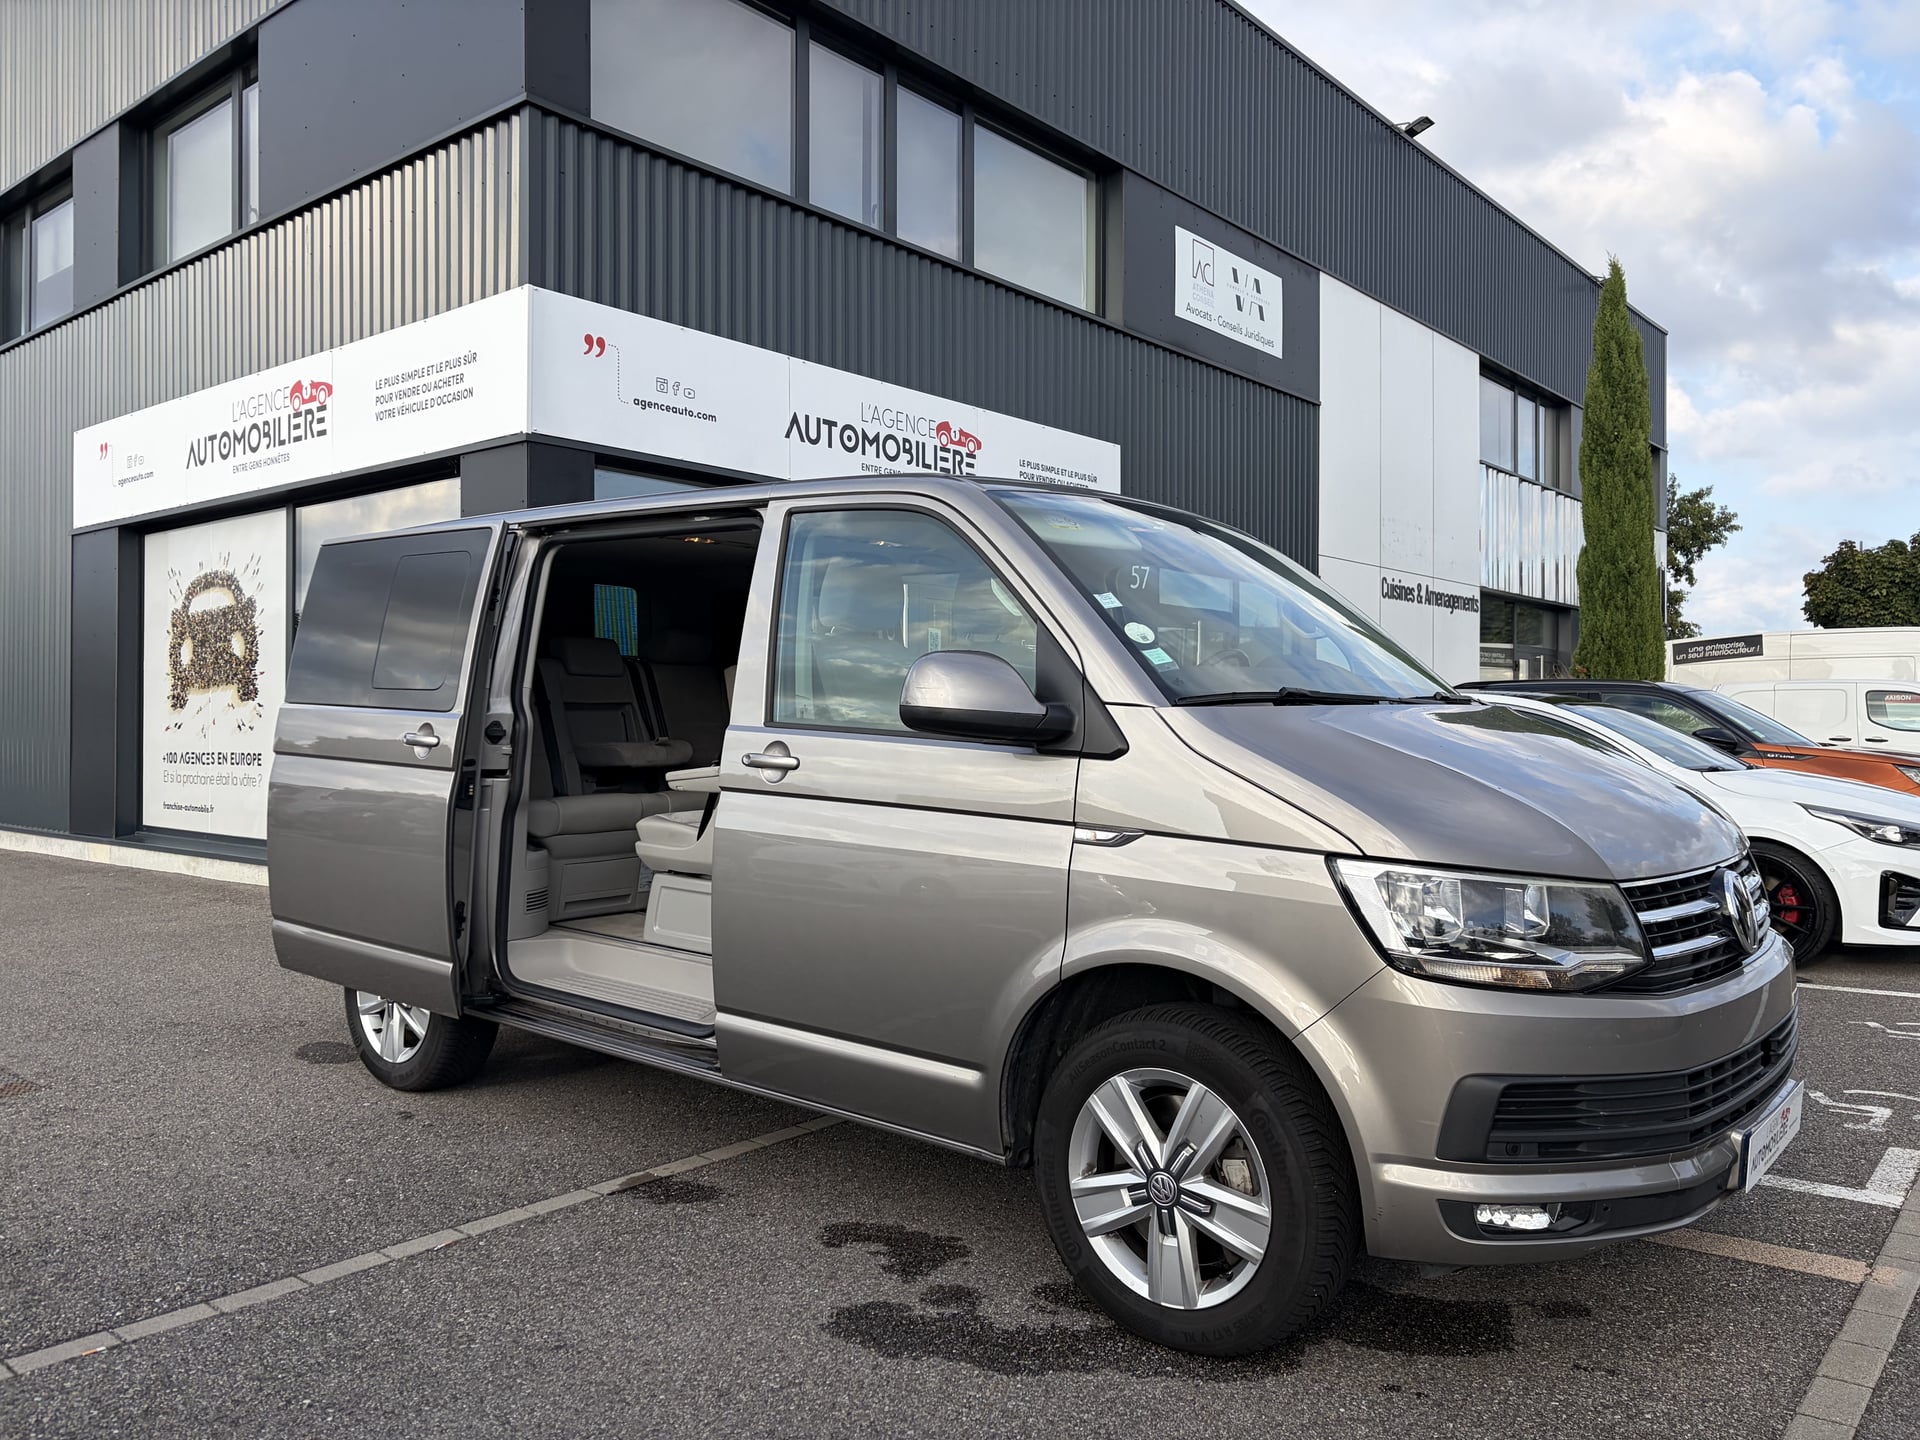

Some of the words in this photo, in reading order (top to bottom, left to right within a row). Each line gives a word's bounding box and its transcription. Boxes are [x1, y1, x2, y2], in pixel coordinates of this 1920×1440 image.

[1185, 301, 1213, 322] Avocats
[1217, 314, 1243, 336] Conseils
[1244, 327, 1275, 349] Juridiques
[375, 379, 383, 390] LE
[384, 374, 400, 388] PLUS
[401, 367, 425, 383] SIMPLE
[426, 364, 435, 377] ET
[435, 361, 444, 374] LE
[444, 356, 462, 371] PLUS
[463, 350, 477, 366] SÛR
[375, 392, 394, 406] POUR
[394, 385, 421, 401] VENDRE
[421, 381, 432, 394] OU
[432, 372, 465, 391] ACHETER
[232, 386, 290, 422] L'AGENCE
[375, 407, 396, 422] VOTRE
[396, 399, 429, 416] VÉHICULE
[430, 386, 474, 409] D'OCCASION
[633, 397, 717, 423] agenceauto.com
[860, 401, 937, 440] L'AGENCE
[232, 461, 248, 474] ENTRE
[249, 458, 262, 471] GENS
[263, 452, 290, 467] HONNÊTES
[861, 463, 882, 475] ENTRE
[1019, 458, 1026, 468] LE
[1026, 460, 1040, 471] PLUS
[1040, 464, 1060, 475] SIMPLE
[1060, 468, 1067, 477] ET
[1067, 470, 1074, 479] LE
[1074, 471, 1087, 481] PLUS
[1087, 473, 1098, 484] SÛR
[118, 471, 154, 488] agenceauto.com
[1019, 470, 1034, 481] POUR
[1130, 565, 1150, 589] 57
[1381, 576, 1415, 603] Cuisines
[1416, 582, 1424, 605] &
[1424, 584, 1480, 615] Amenagements
[1676, 653, 1687, 661] un
[1687, 650, 1704, 659] seul
[1705, 646, 1755, 657] interlocuteur
[1688, 645, 1704, 653] une
[1705, 641, 1746, 652] entreprise,
[162, 751, 178, 766] +100
[179, 752, 215, 766] AGENCES
[217, 752, 228, 766] EN
[230, 752, 262, 767] EUROPE
[163, 770, 169, 783] Et
[170, 770, 175, 783] si
[175, 770, 182, 784] la
[182, 771, 215, 787] prochaine
[215, 772, 230, 786] était
[230, 772, 238, 785] la
[239, 772, 257, 787] vôtre
[1158, 1039, 1167, 1051] 2
